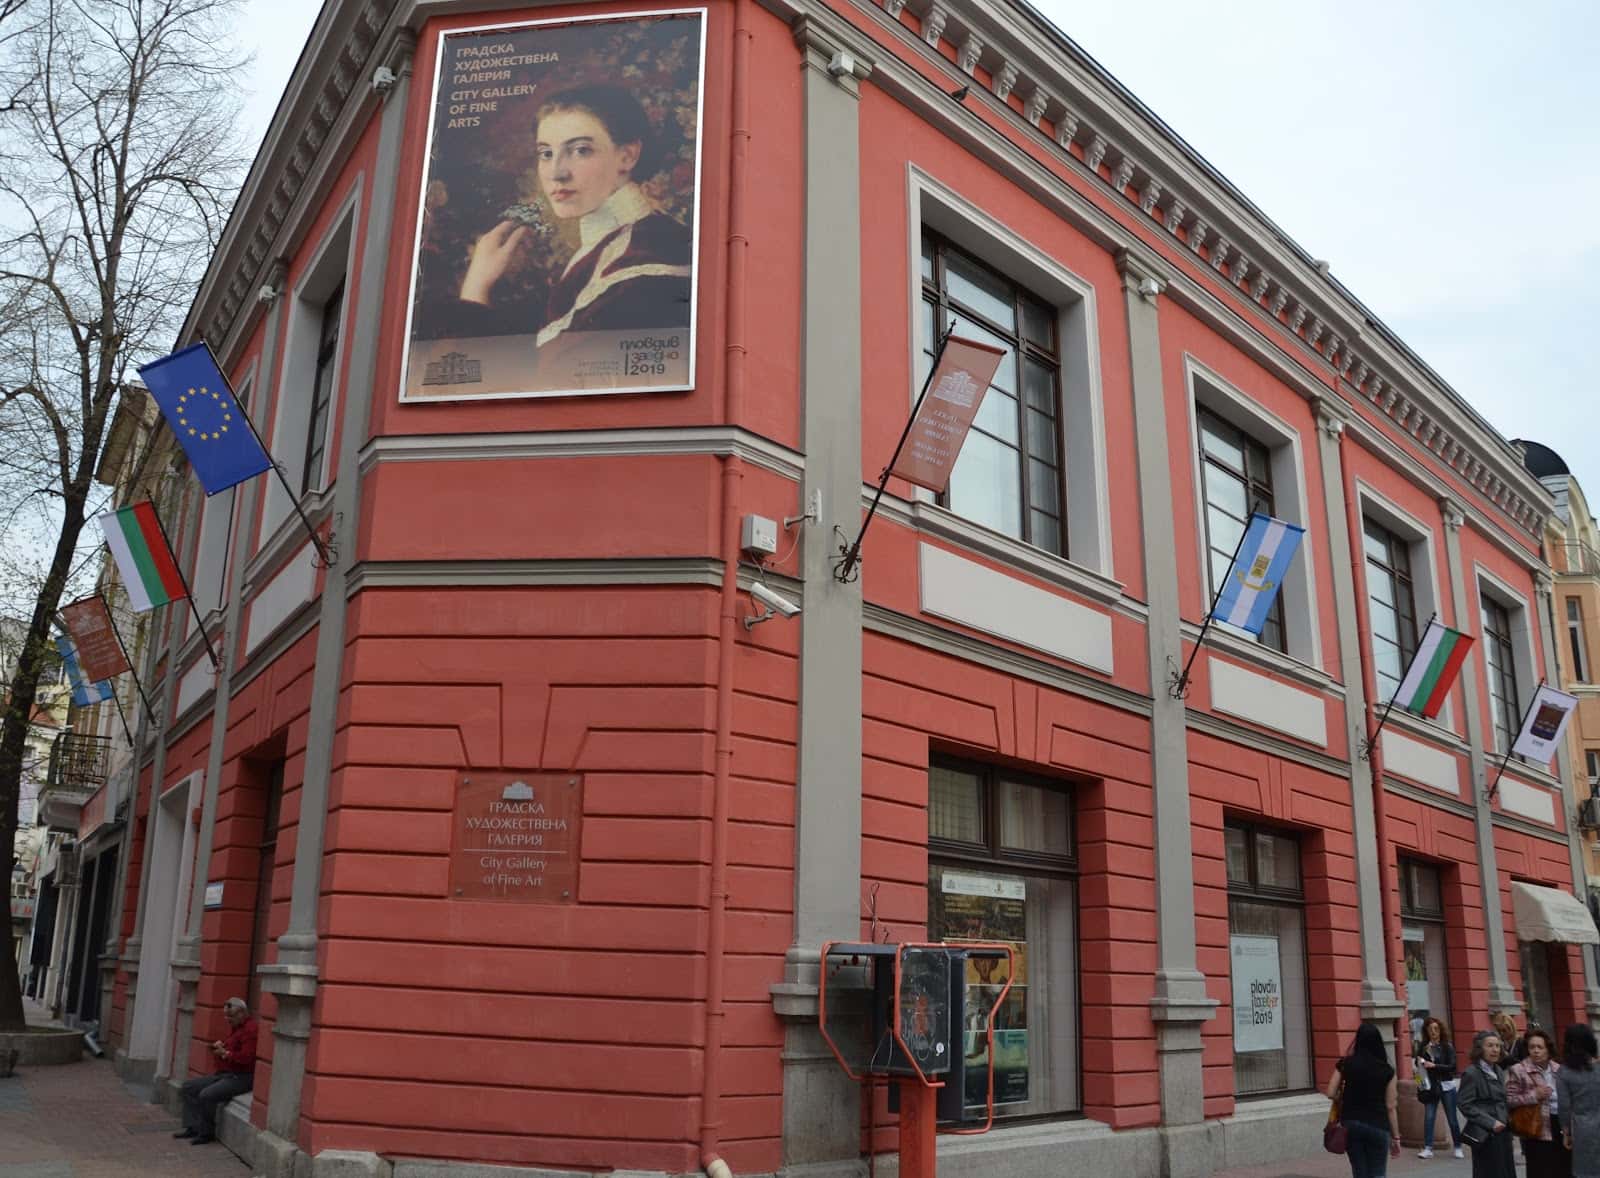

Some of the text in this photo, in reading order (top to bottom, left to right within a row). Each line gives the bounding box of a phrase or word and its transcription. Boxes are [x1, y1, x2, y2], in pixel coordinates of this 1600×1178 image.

[457, 44, 514, 57] ГРАДСКА
[455, 53, 559, 71] ХУДОЖЕСТВЕНА
[454, 70, 511, 84] ГАЛЕРИЯ
[451, 85, 537, 101] CITY GALLERY
[449, 101, 497, 115] OF FINE
[447, 117, 481, 129] ARTS
[630, 364, 665, 376] 2019
[489, 802, 544, 813] ГРАДСКА
[466, 818, 567, 830] ХУДОЖЕСТВЕНА
[488, 832, 543, 846] ГАЛЕРИЯ
[480, 856, 545, 872] City Gallery
[483, 873, 543, 888] of Fine Art
[1254, 1010, 1273, 1025] 2019
